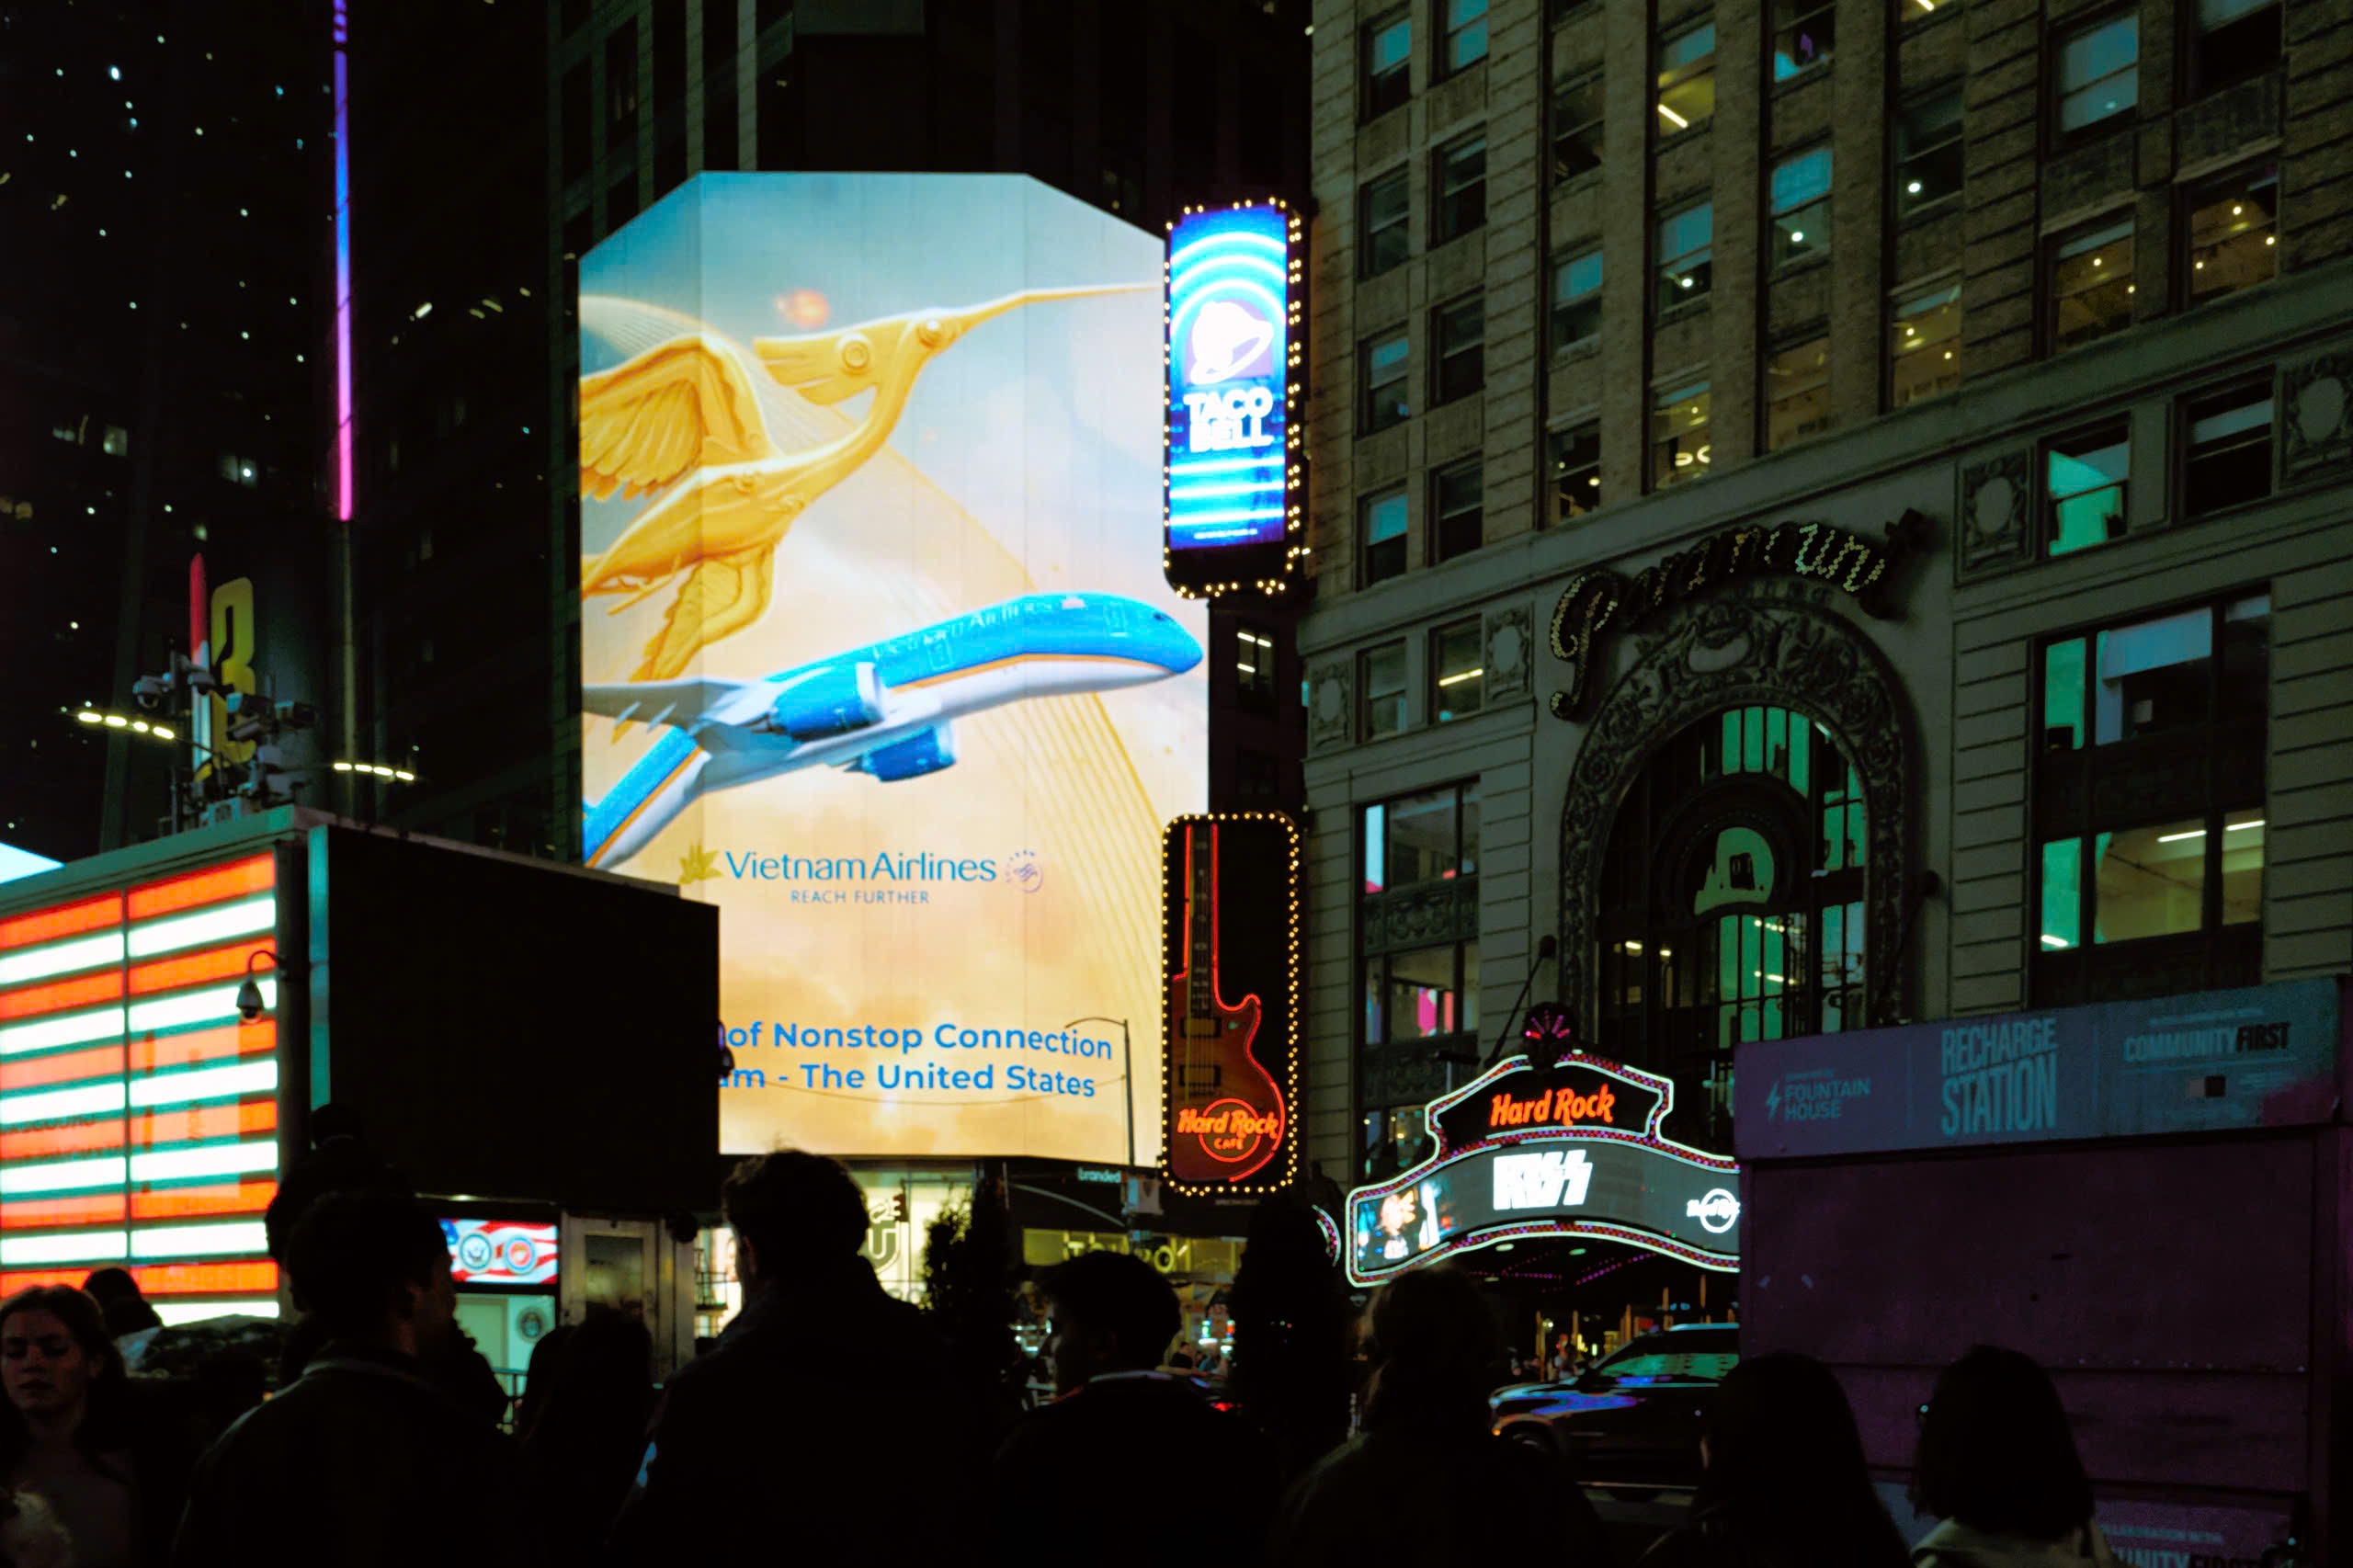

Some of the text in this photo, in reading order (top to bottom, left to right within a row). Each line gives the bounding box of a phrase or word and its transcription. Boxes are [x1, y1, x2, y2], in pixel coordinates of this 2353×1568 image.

[1183, 386, 1274, 422] TACO
[1190, 416, 1275, 452] BELL
[725, 850, 997, 881] Vietnam Airlines
[790, 890, 929, 904] REACH FURTHER
[727, 1021, 1112, 1060] of Nonstop Connection
[1941, 1017, 2059, 1077] RECHARGE
[800, 1062, 865, 1089] The
[877, 1062, 994, 1090] United
[1006, 1064, 1096, 1097] States
[1784, 1076, 1872, 1103] FOUNTAIN
[1941, 1051, 2057, 1138] STATION
[1490, 1083, 1616, 1128] Hard Rock
[1785, 1098, 1844, 1122] HOUSE
[1177, 1108, 1279, 1140] Hard Rock
[1213, 1137, 1244, 1150] CAFE
